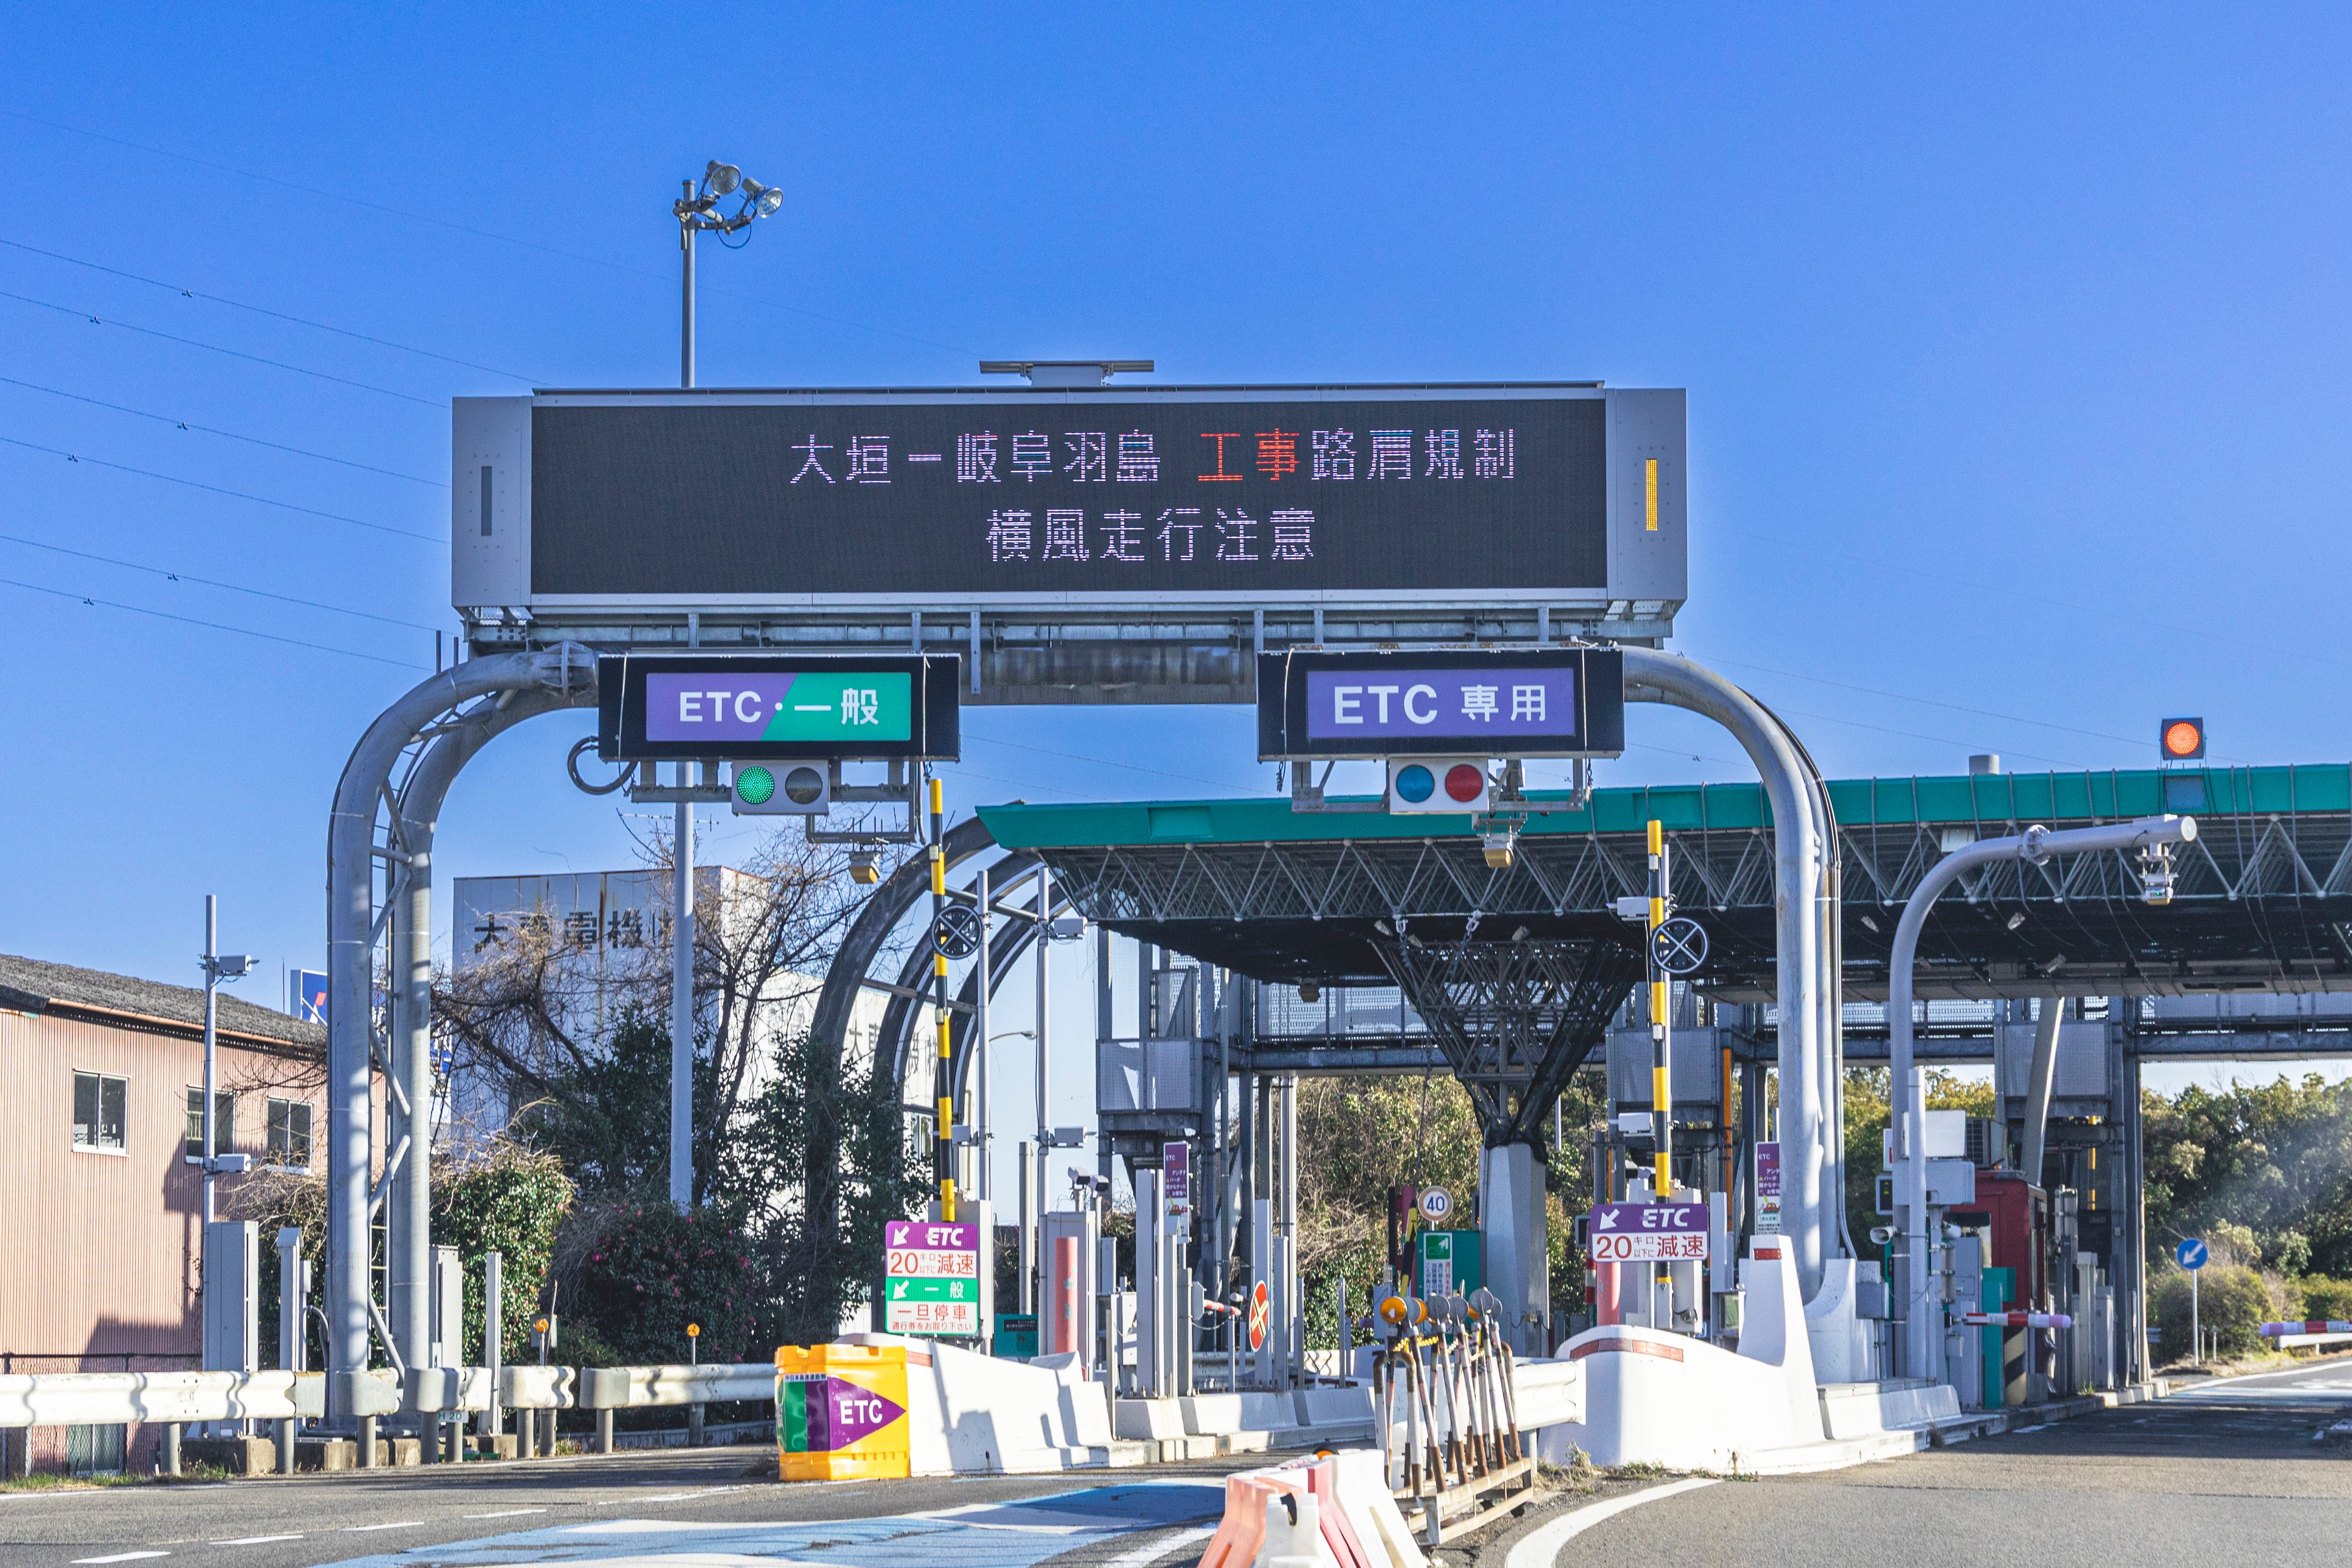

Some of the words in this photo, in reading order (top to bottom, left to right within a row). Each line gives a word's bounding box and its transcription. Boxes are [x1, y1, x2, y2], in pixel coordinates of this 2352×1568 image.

[986, 508, 1315, 562] 横風走行注意
[1334, 684, 1438, 724] ETC
[1461, 684, 1546, 722] 専用
[1427, 1196, 1445, 1212] 40
[1642, 1208, 1690, 1228] ETC
[927, 1227, 964, 1246] ETC
[1633, 1236, 1654, 1245] キロ
[1597, 1235, 1632, 1259] 20
[1634, 1248, 1654, 1258] 以下に
[1657, 1235, 1704, 1258] 減速
[890, 1252, 918, 1273] 20
[937, 1254, 974, 1275] 減速
[924, 1281, 964, 1299] 一般
[898, 1304, 967, 1321] 一旦停車
[892, 1321, 972, 1331] 通行券をお取り下さい
[449, 1411, 462, 1420] 20
[840, 1399, 883, 1424] ETC
